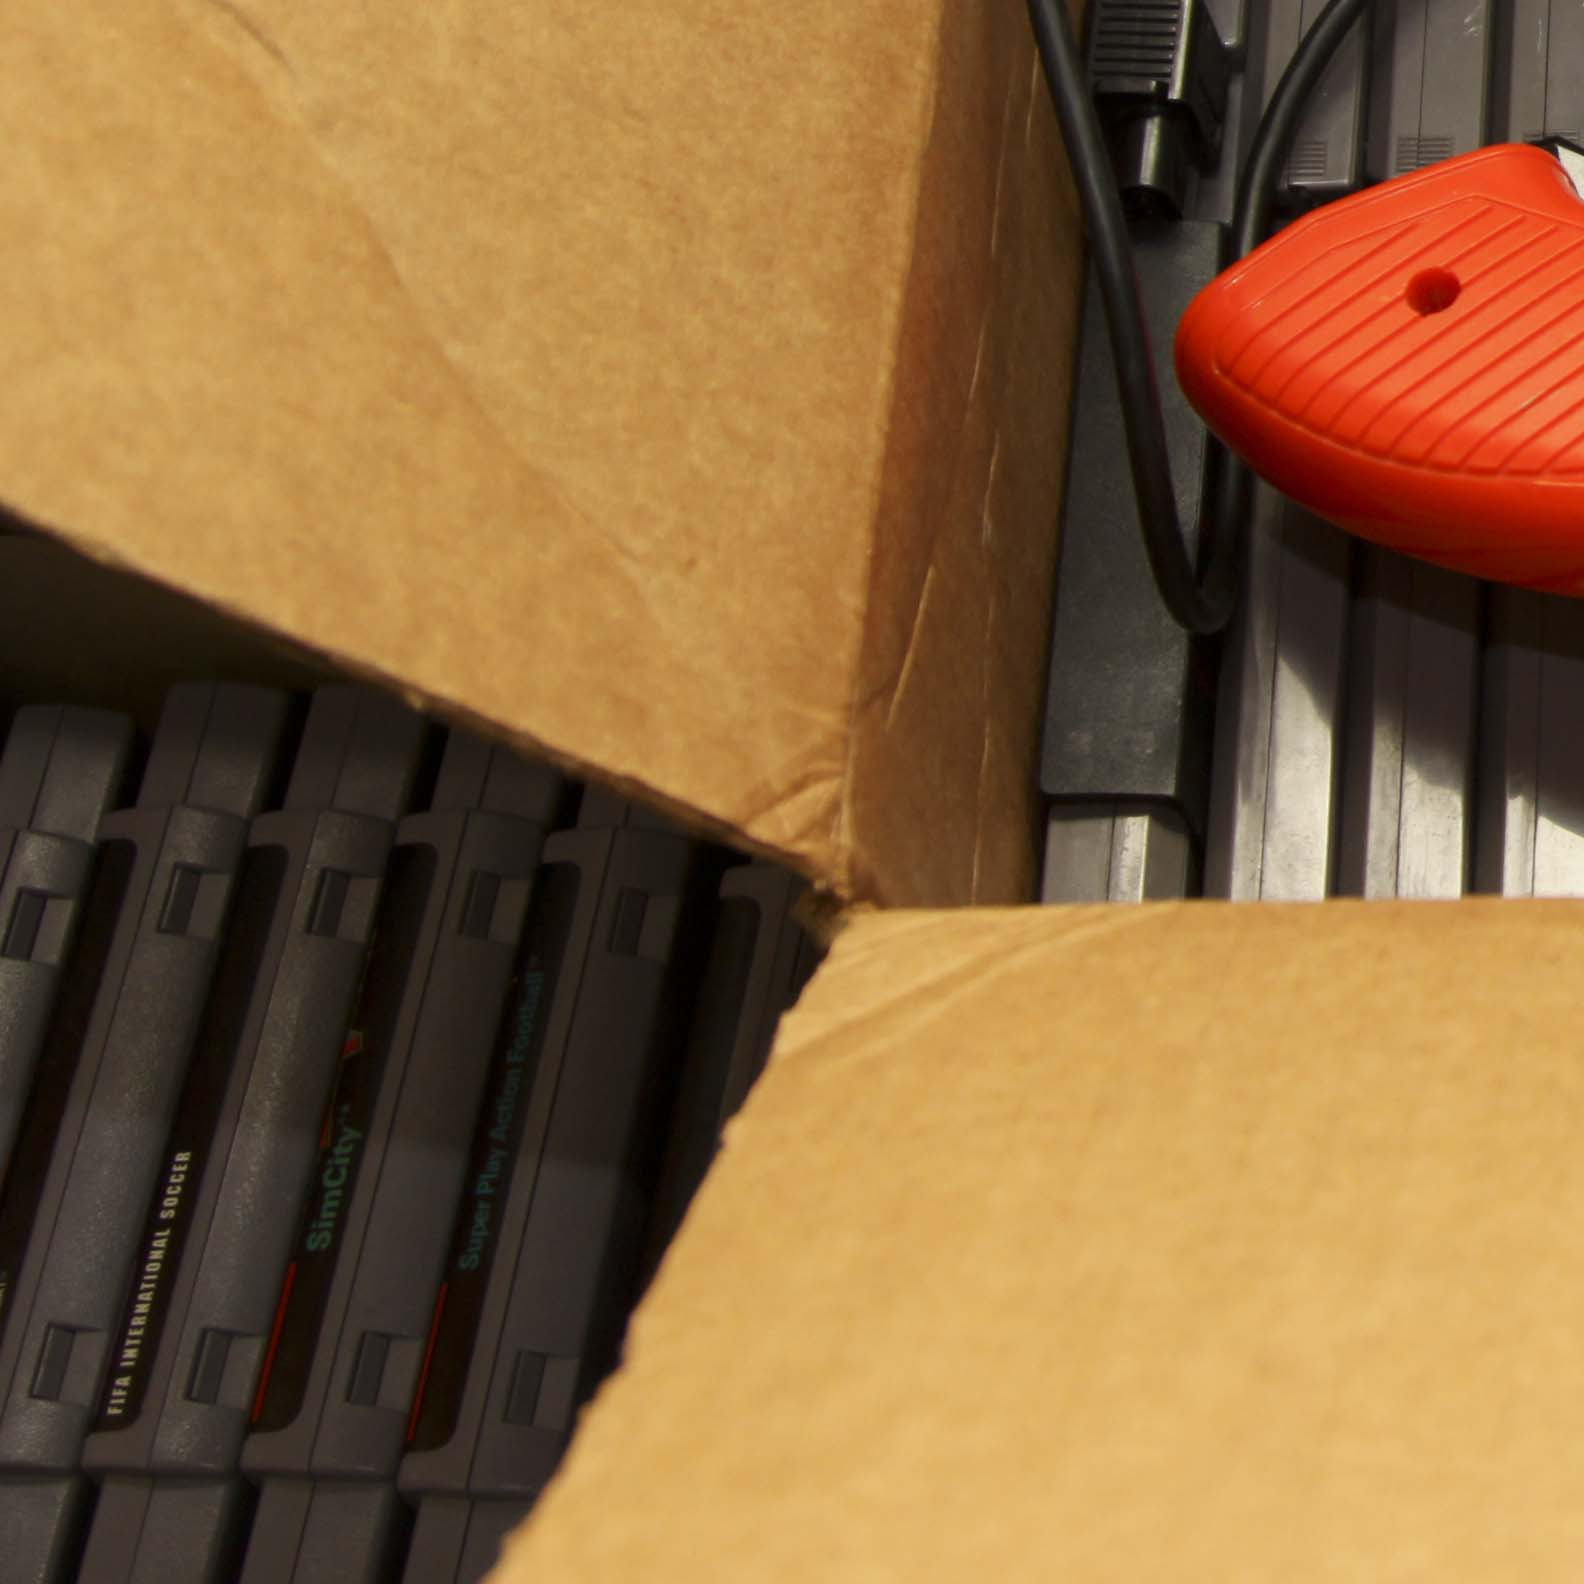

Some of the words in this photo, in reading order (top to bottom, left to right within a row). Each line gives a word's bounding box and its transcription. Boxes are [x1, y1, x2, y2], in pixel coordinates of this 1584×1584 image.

[490, 1070, 521, 1141] Action
[305, 1126, 362, 1252] SimCity
[475, 1148, 508, 1195] Play
[457, 1202, 491, 1271] Super
[106, 1376, 132, 1415] FIFA
[120, 1228, 171, 1366] INTERNATIONAL
[160, 1151, 191, 1220] SOCCER
